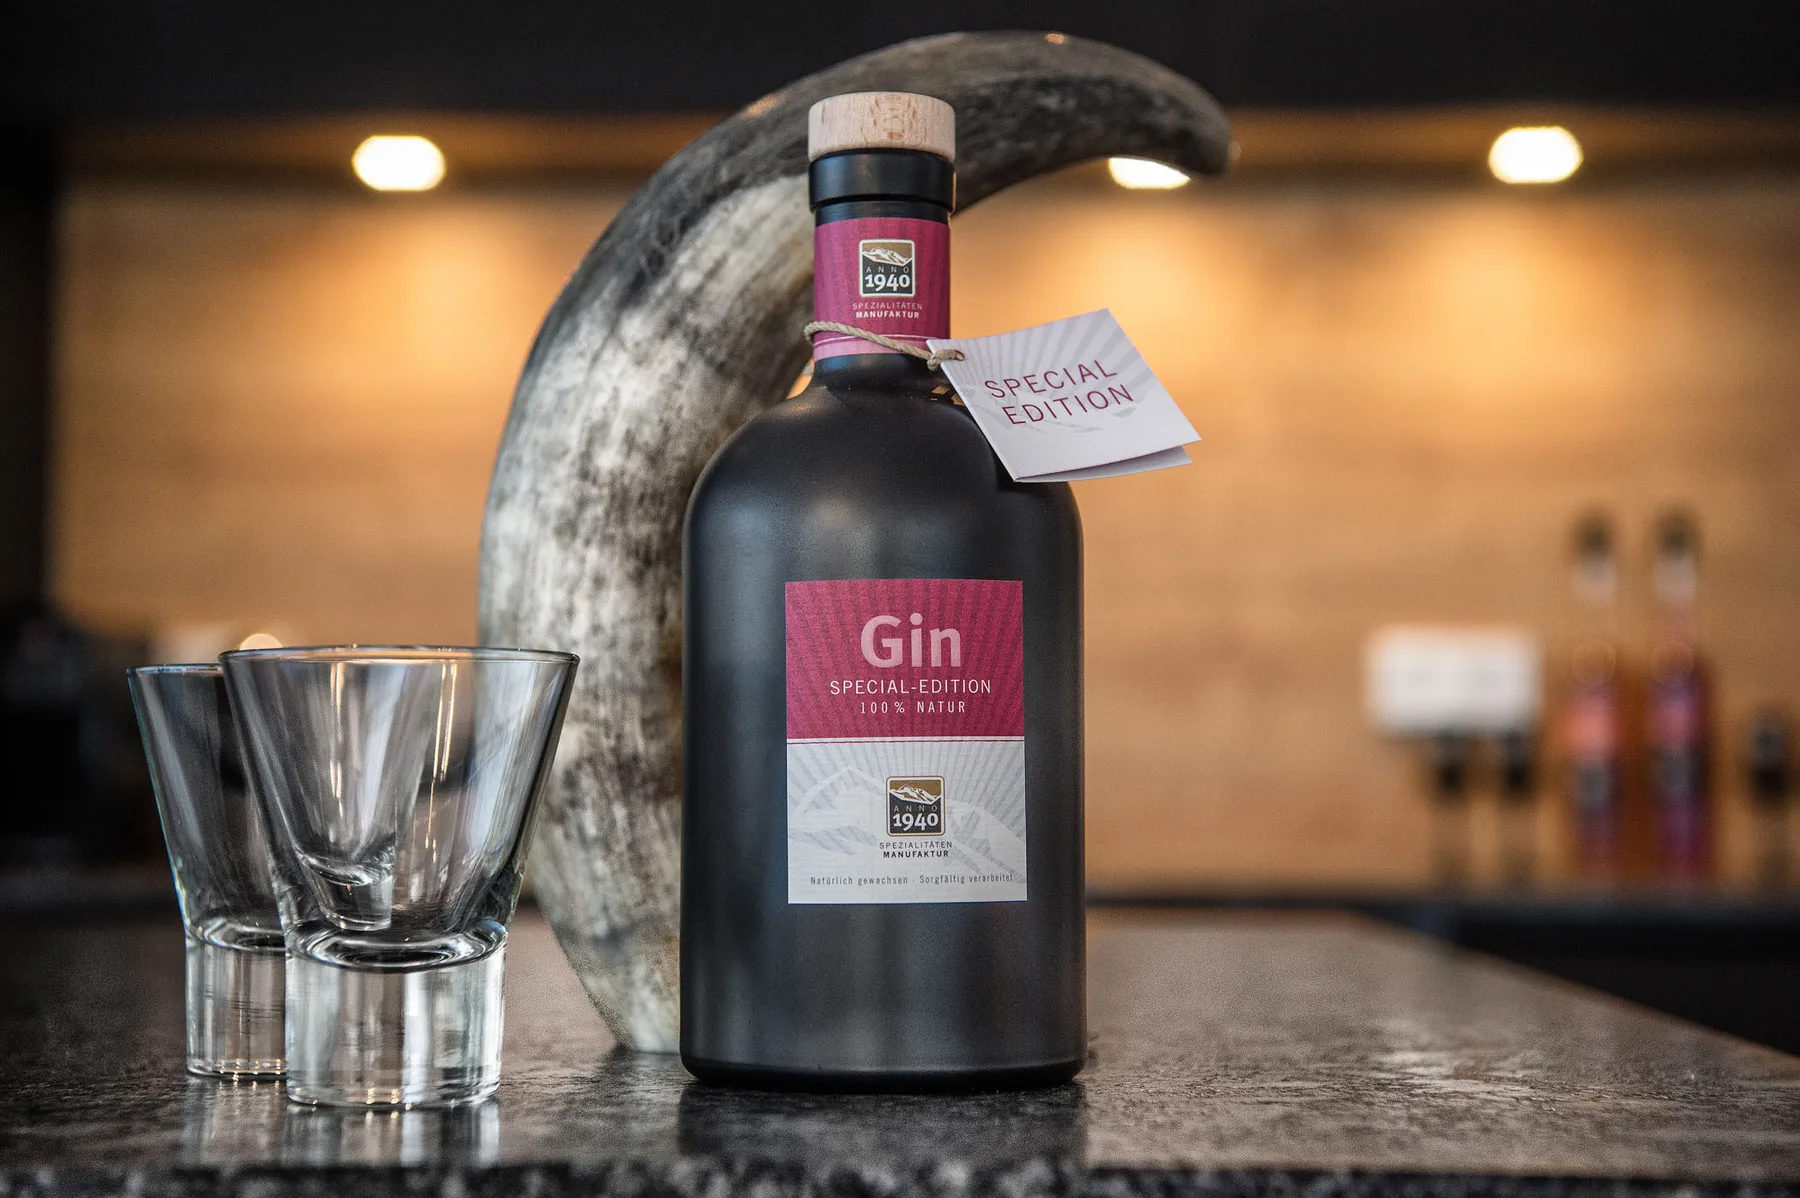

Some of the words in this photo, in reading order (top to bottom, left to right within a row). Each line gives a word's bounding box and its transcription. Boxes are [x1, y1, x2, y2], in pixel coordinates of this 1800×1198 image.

[865, 274, 911, 291] 1940
[855, 311, 919, 319] MANUFAKTUR
[984, 360, 1118, 399] SPECIAL
[1002, 384, 1134, 424] EDITION
[861, 612, 961, 668] Gin
[830, 679, 991, 695] SPECIAL-EDITION
[917, 701, 965, 713] NATUR
[892, 813, 939, 832] 1940
[883, 850, 949, 858] MANUFAKTUR
[810, 876, 853, 886] Natürlich
[857, 876, 908, 886] gewachsen
[919, 874, 965, 885] Sorgfältig
